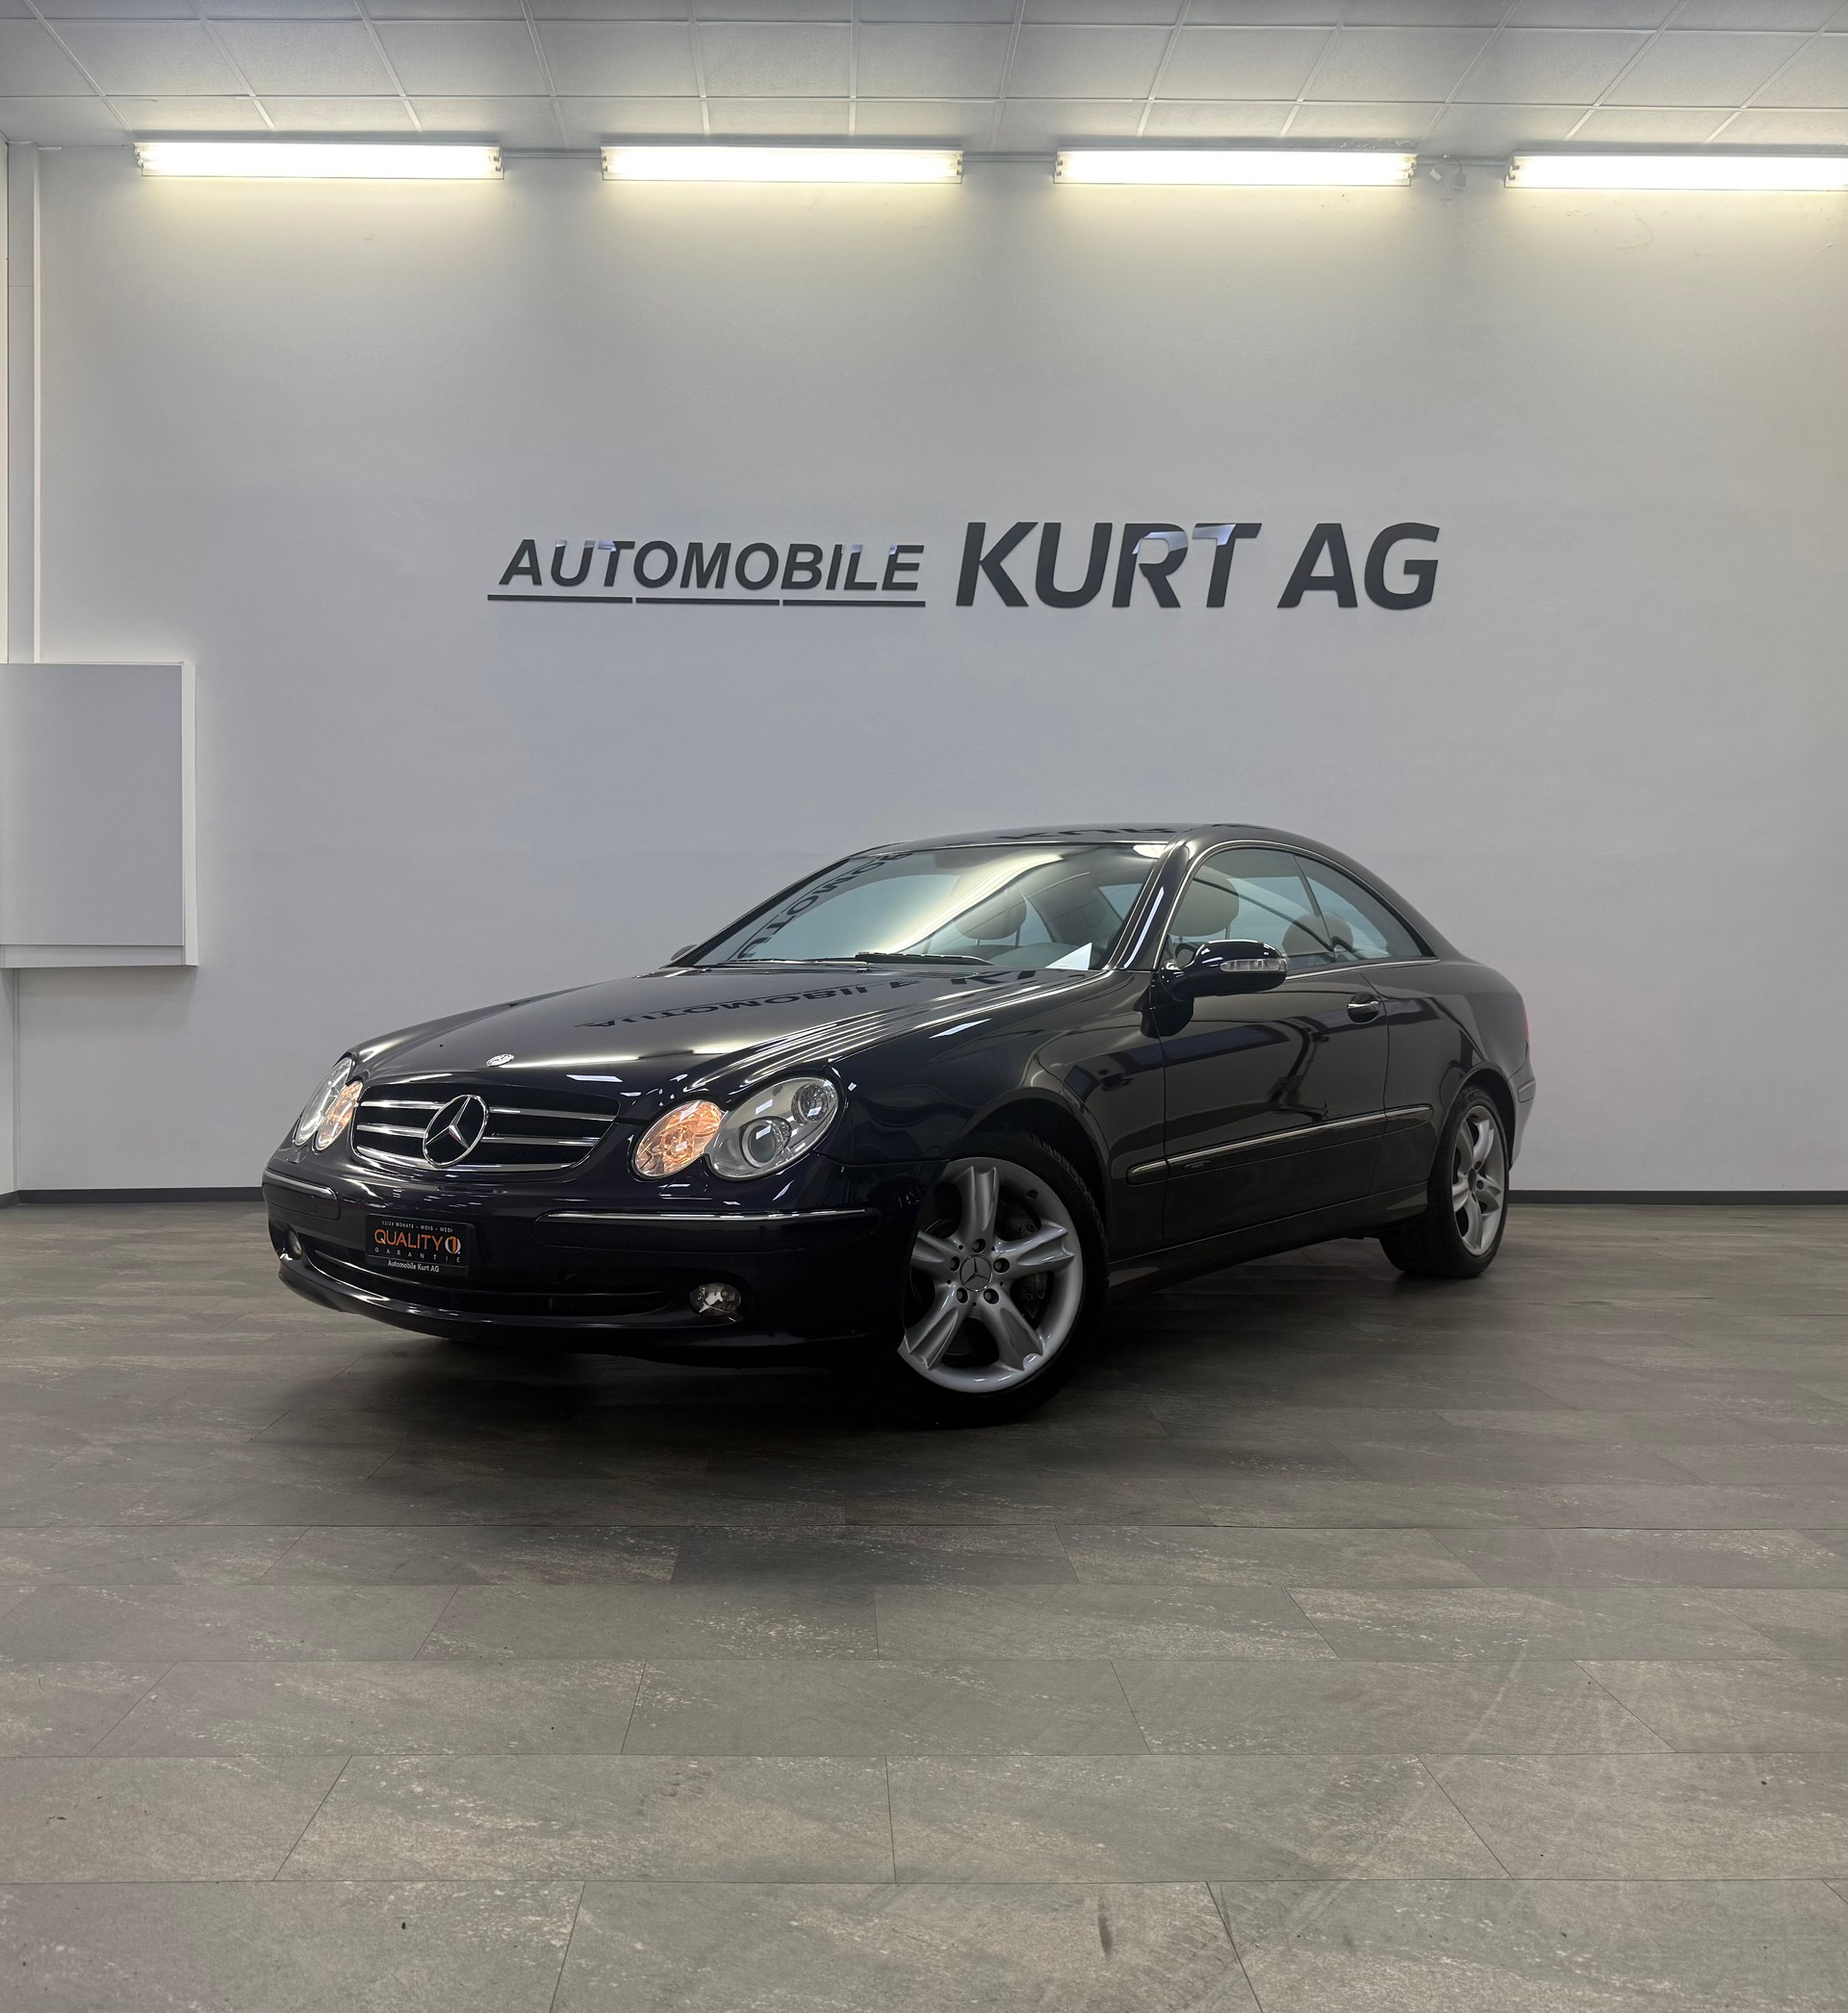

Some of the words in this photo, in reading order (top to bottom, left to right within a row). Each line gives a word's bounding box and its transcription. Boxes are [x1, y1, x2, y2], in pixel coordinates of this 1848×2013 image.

[498, 538, 925, 591] AUTOMOBILE
[956, 522, 1263, 608] KURT
[1276, 522, 1441, 610] AG
[374, 1247, 461, 1263] GARANTIE
[387, 1259, 417, 1271] Automobile
[417, 1263, 430, 1272] Kurt
[430, 1264, 440, 1273] AG
